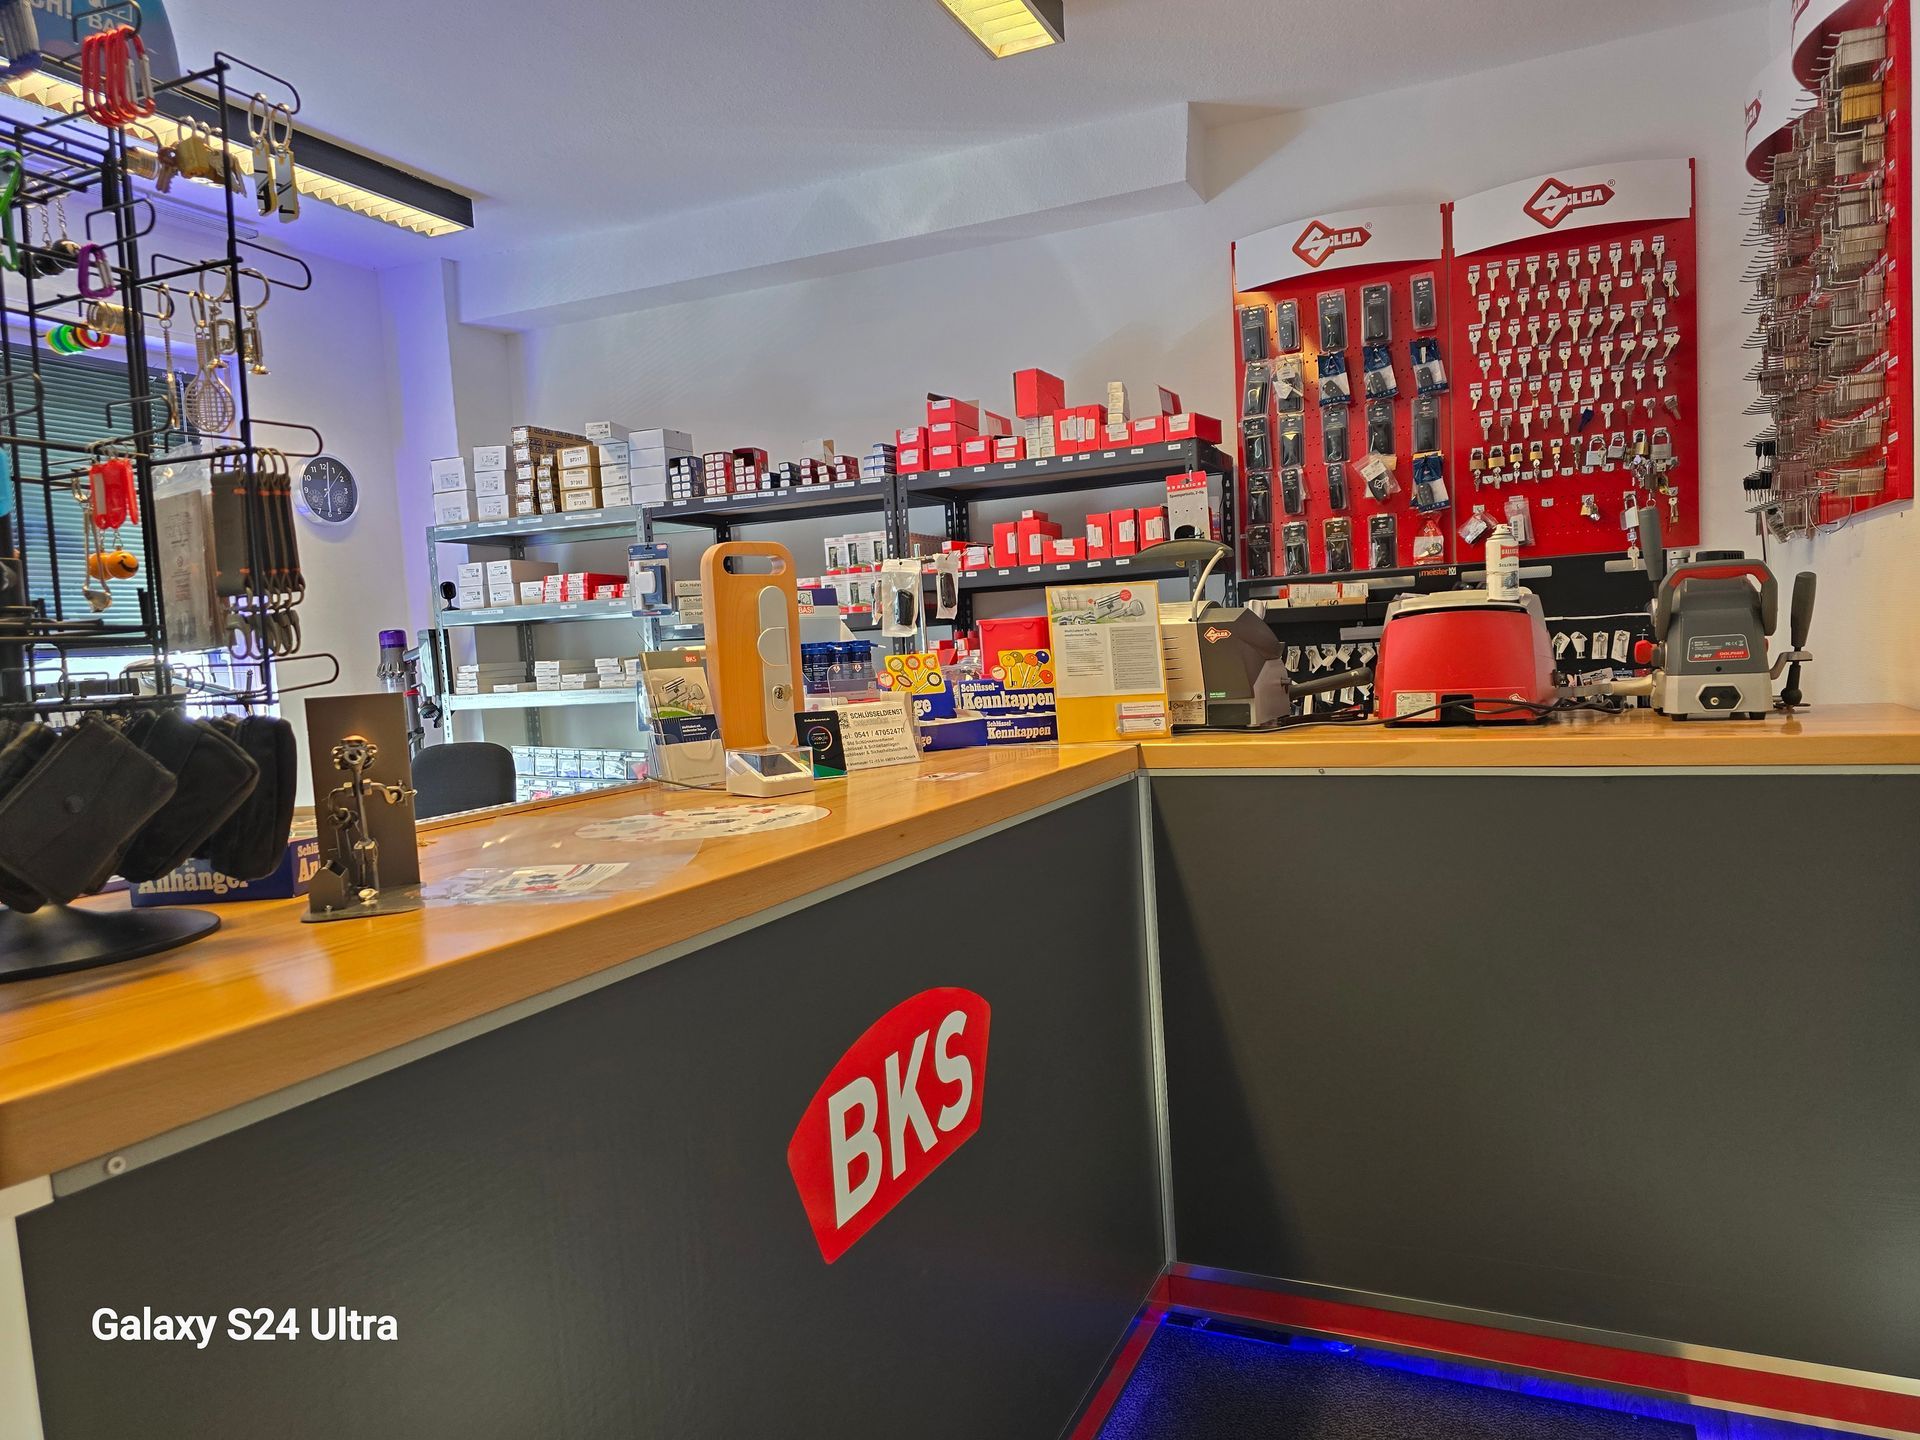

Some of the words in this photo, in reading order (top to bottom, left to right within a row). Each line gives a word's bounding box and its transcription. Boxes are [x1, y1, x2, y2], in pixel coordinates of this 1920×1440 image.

[1531, 184, 1604, 221] SILCA
[1299, 226, 1362, 261] SILCA
[1420, 567, 1449, 577] meister
[960, 682, 999, 693] Schlüssel-
[961, 691, 1055, 710] Kennkappen
[850, 709, 903, 719] SCHLÜSSELDIENST
[854, 731, 870, 739] 0541
[987, 724, 1051, 740] Kennkappen
[828, 1010, 973, 1229] BKS
